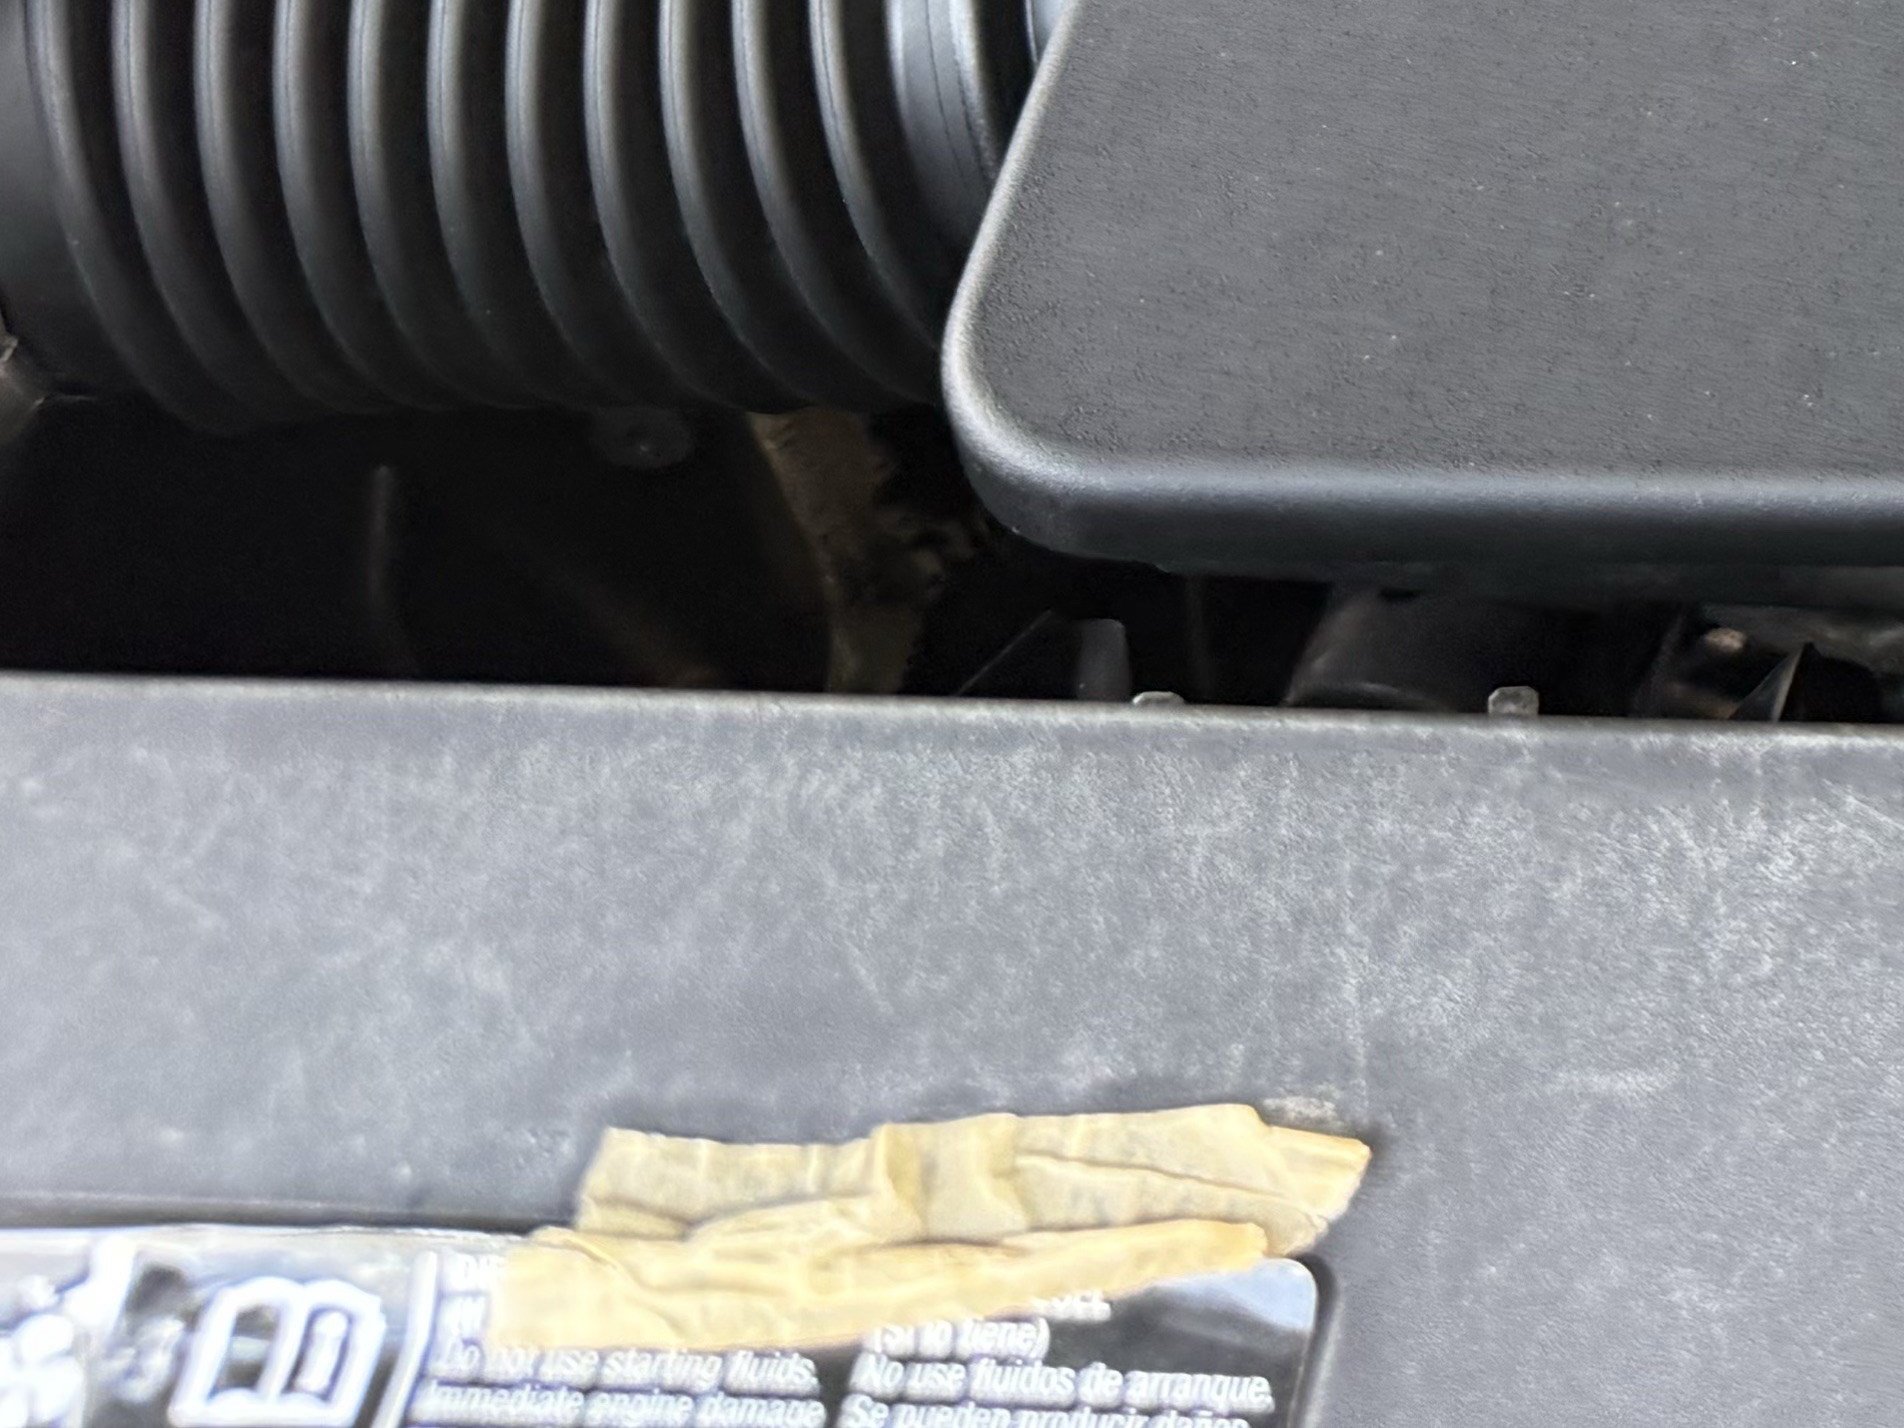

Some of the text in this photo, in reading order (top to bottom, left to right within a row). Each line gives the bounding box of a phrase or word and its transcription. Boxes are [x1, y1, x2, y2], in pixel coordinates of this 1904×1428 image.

[544, 1349, 599, 1377] use
[602, 1347, 723, 1385] starting
[726, 1350, 819, 1385] fluids.
[862, 1356, 1274, 1416] No use fluidos de arranque.
[428, 1380, 826, 1428] Immediate engine damage
[852, 1395, 890, 1427] Se
